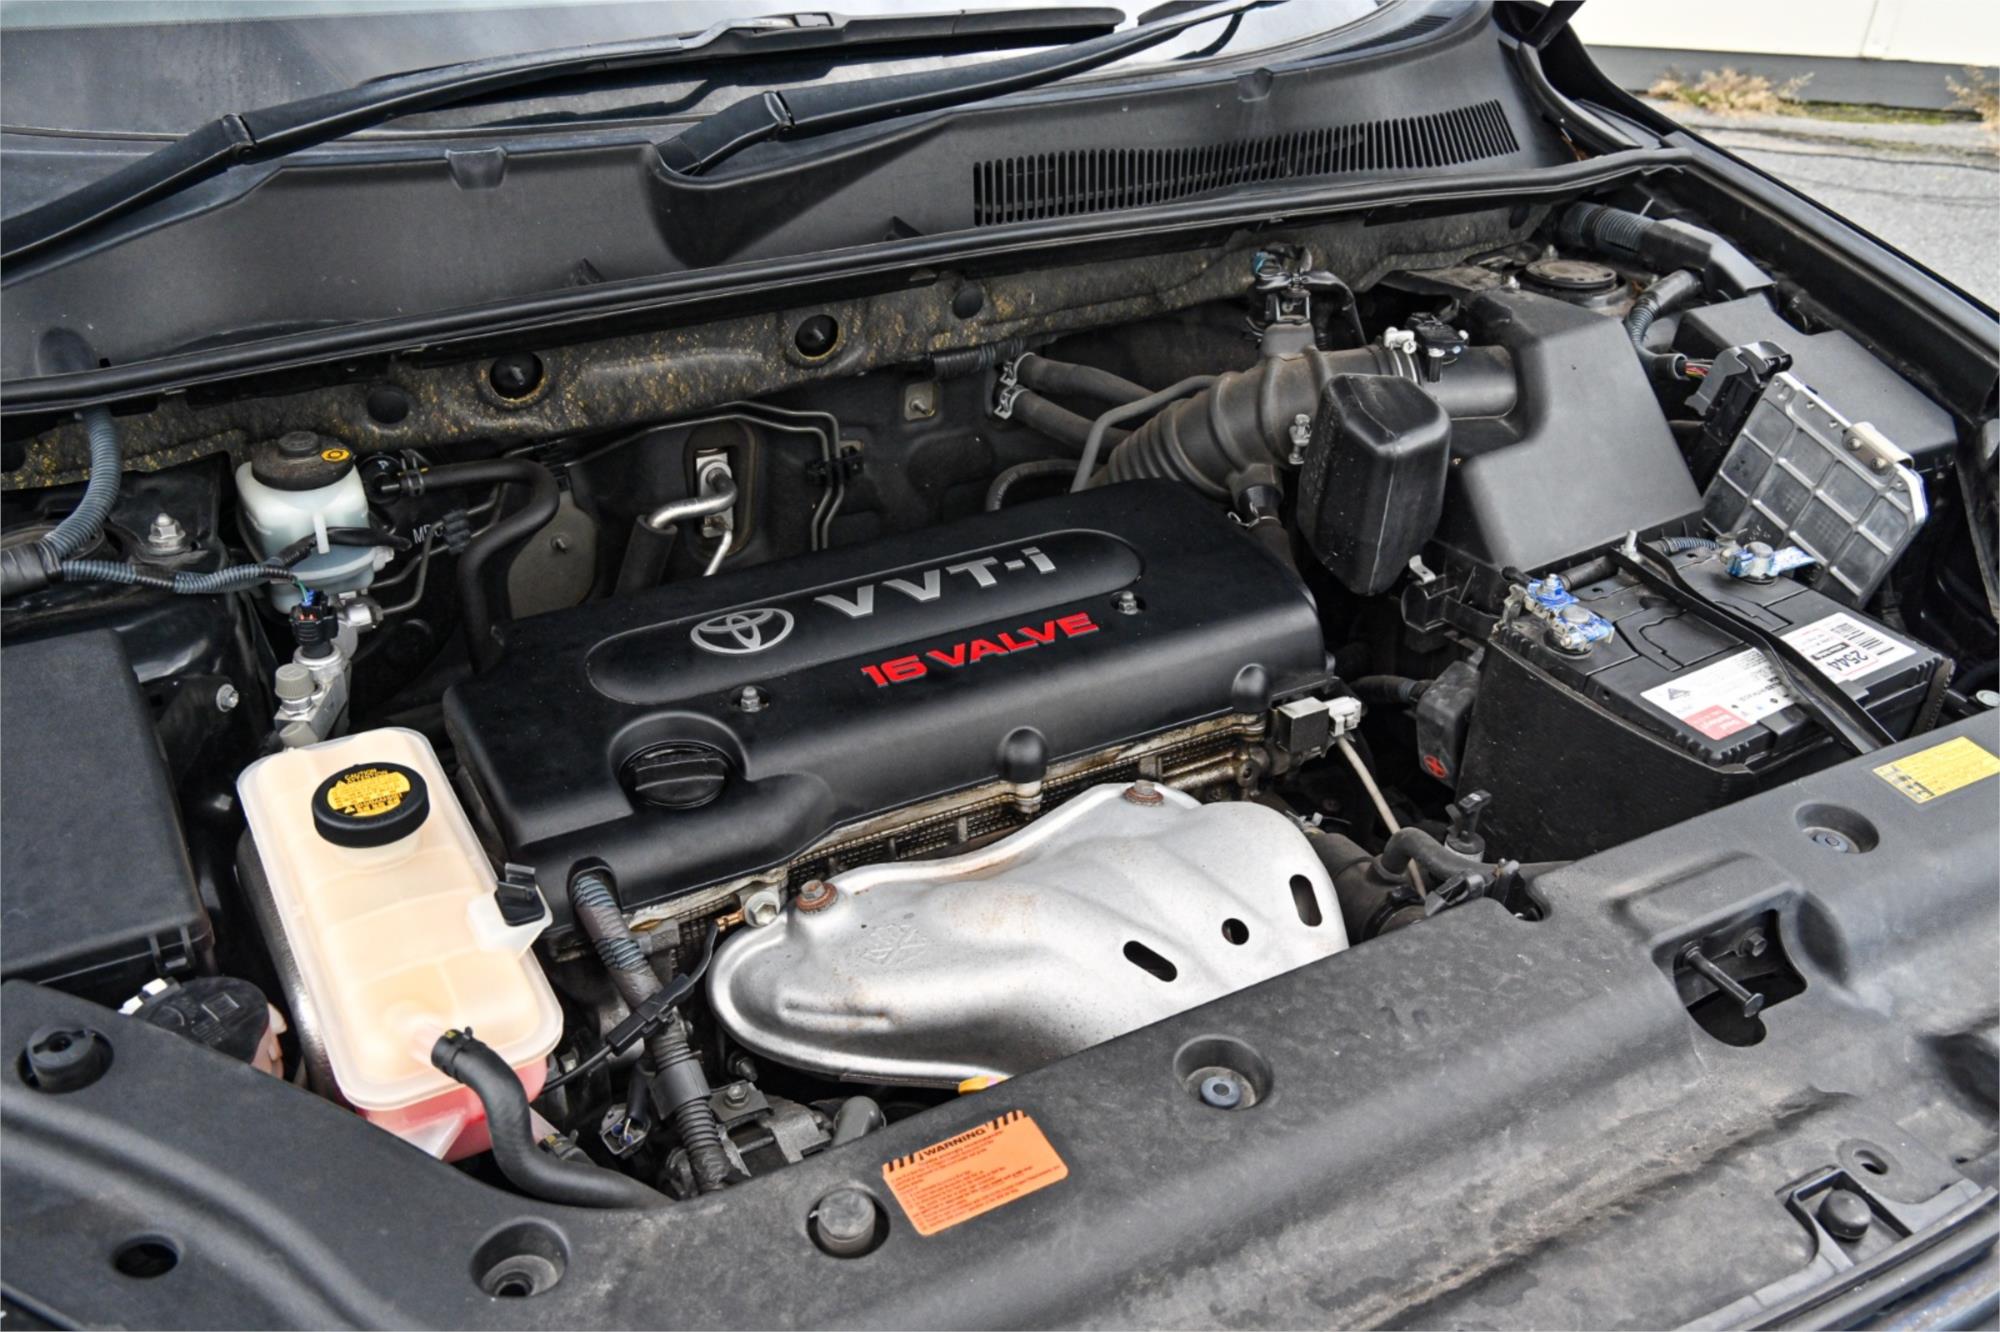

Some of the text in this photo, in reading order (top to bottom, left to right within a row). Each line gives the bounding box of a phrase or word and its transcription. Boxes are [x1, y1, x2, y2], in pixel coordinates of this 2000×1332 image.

[814, 546, 1057, 619] VVT-i
[861, 612, 1100, 688] 16 VALVE
[1827, 650, 1869, 672] 2544
[923, 1127, 987, 1157] WARNING
